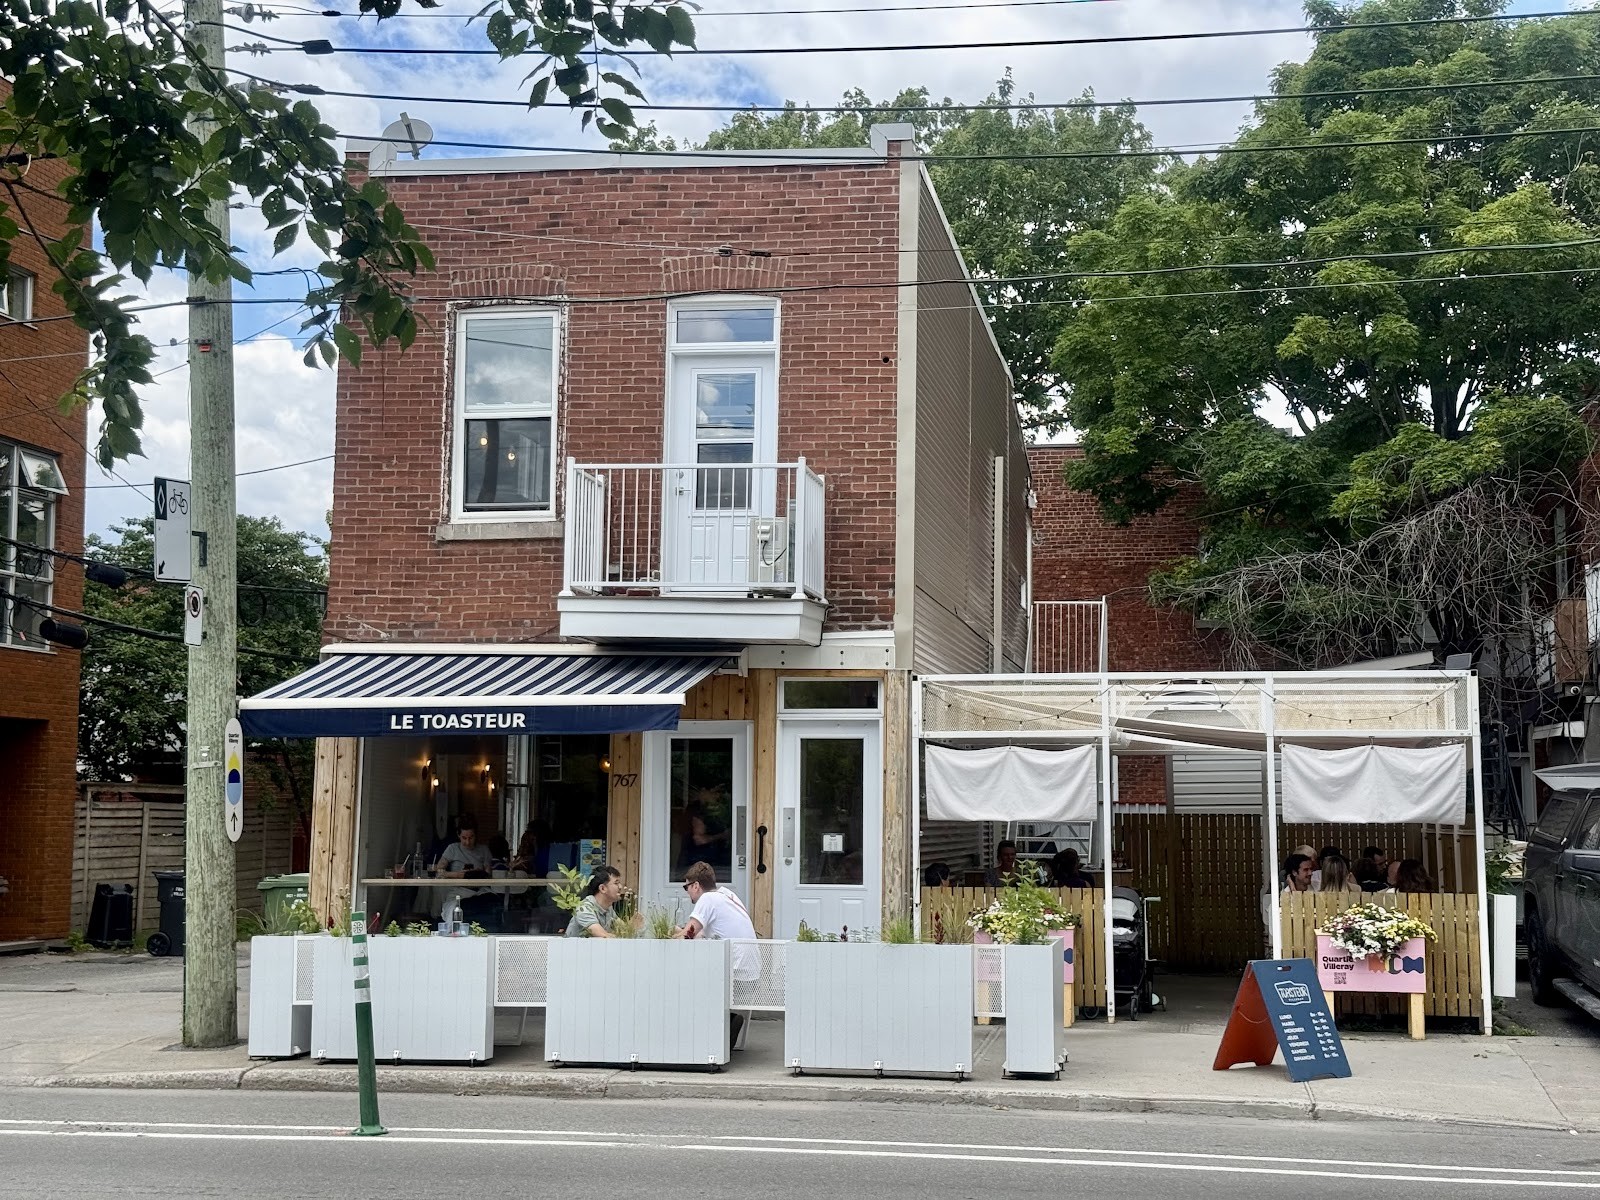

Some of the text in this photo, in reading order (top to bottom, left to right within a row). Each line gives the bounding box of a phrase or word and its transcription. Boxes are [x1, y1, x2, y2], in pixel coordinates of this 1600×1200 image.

[390, 712, 526, 730] LE TOASTEUR
[613, 773, 638, 788] 767
[1278, 986, 1308, 999] TOASTEUR
